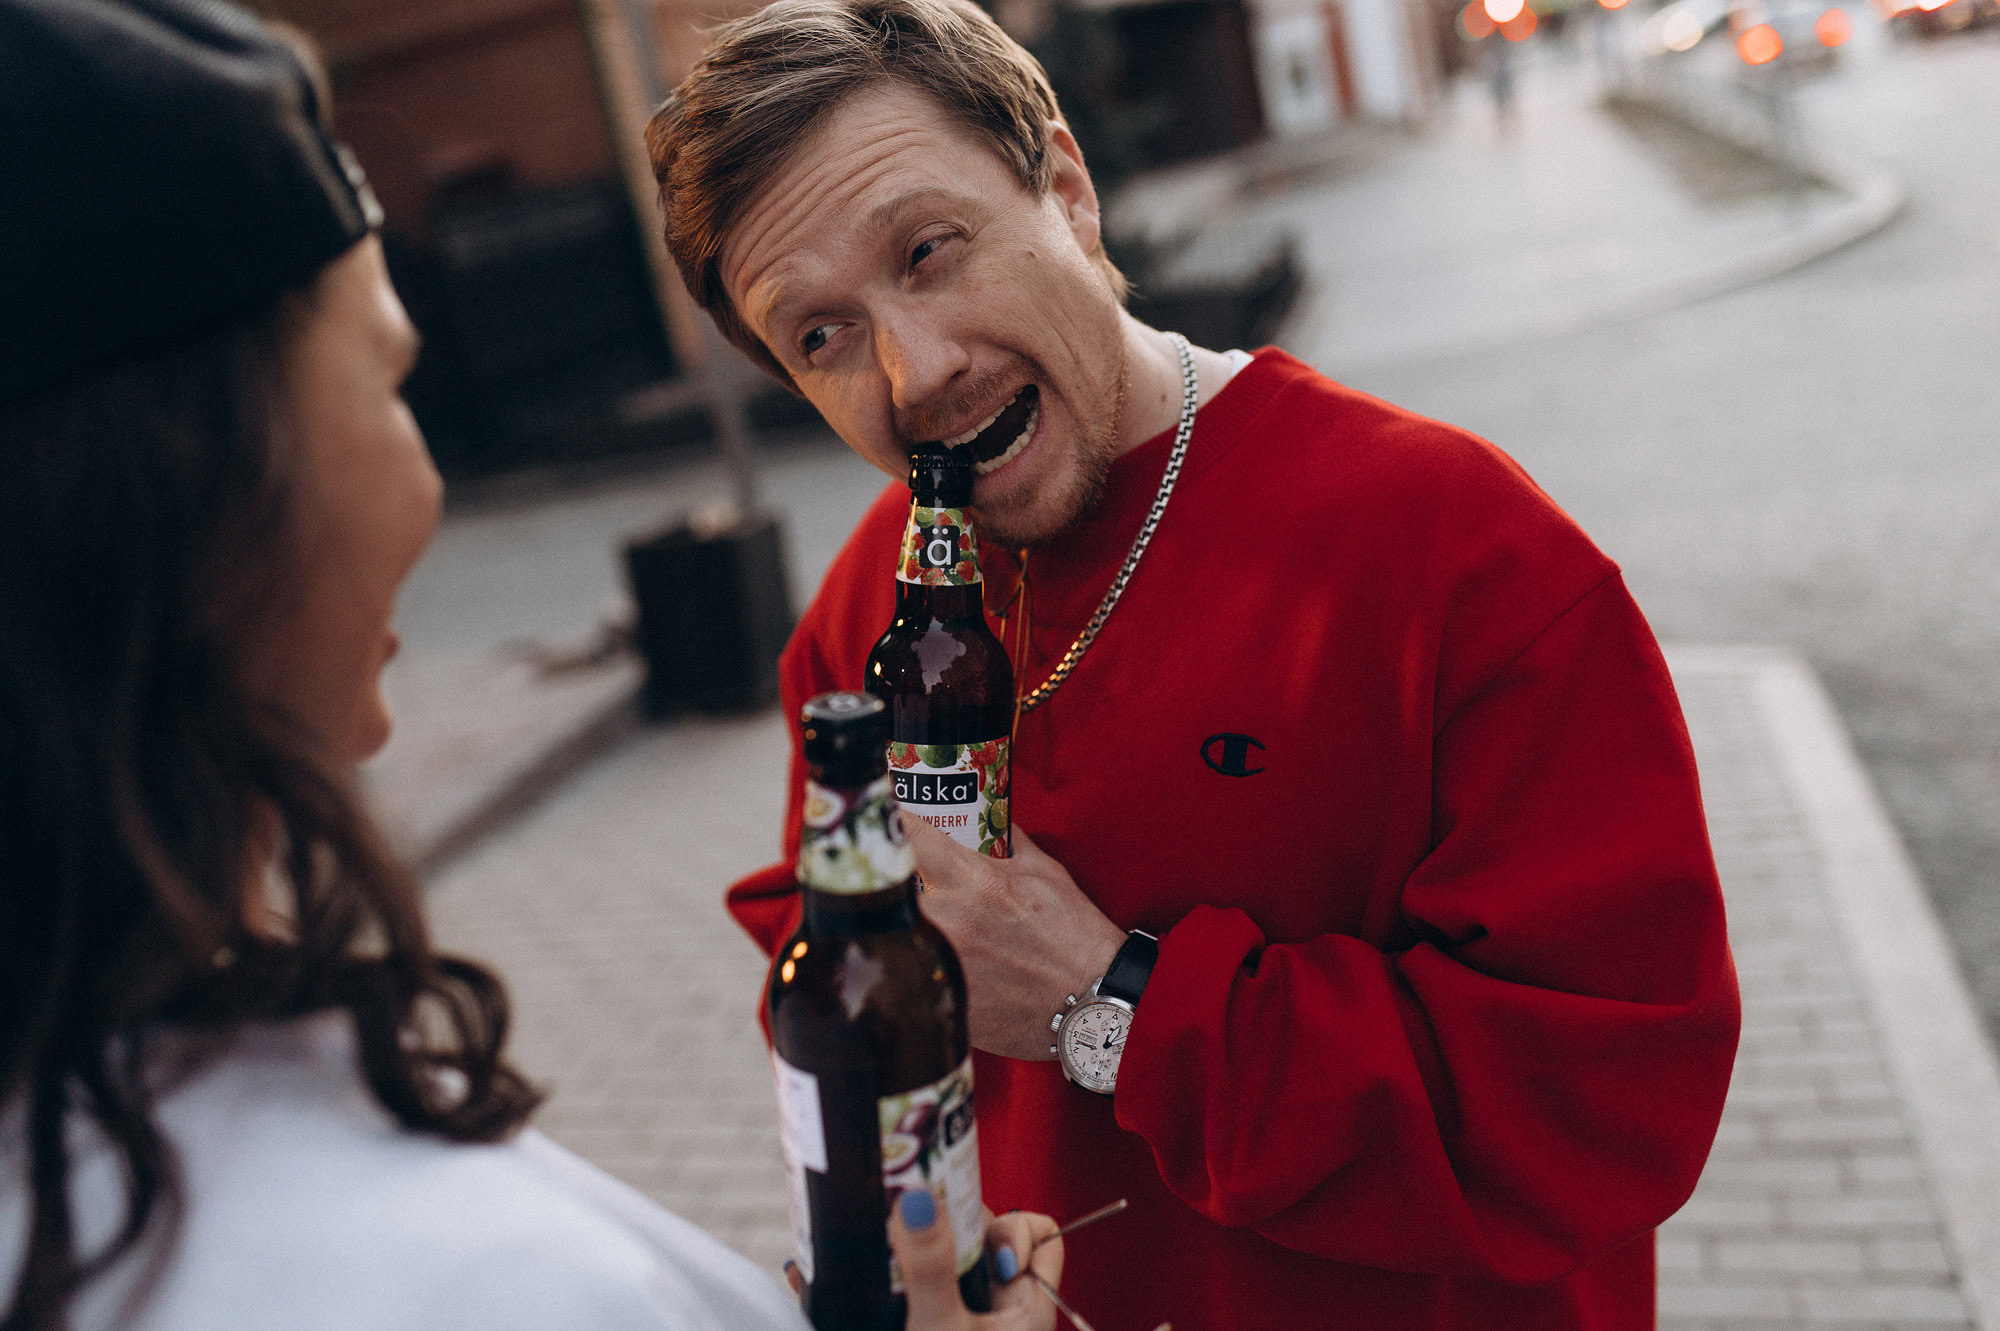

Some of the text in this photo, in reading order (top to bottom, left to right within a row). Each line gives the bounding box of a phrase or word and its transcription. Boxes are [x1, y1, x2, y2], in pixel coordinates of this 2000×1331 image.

[926, 527, 952, 566] ä
[895, 774, 968, 801] älska
[918, 814, 969, 828] WBERRY
